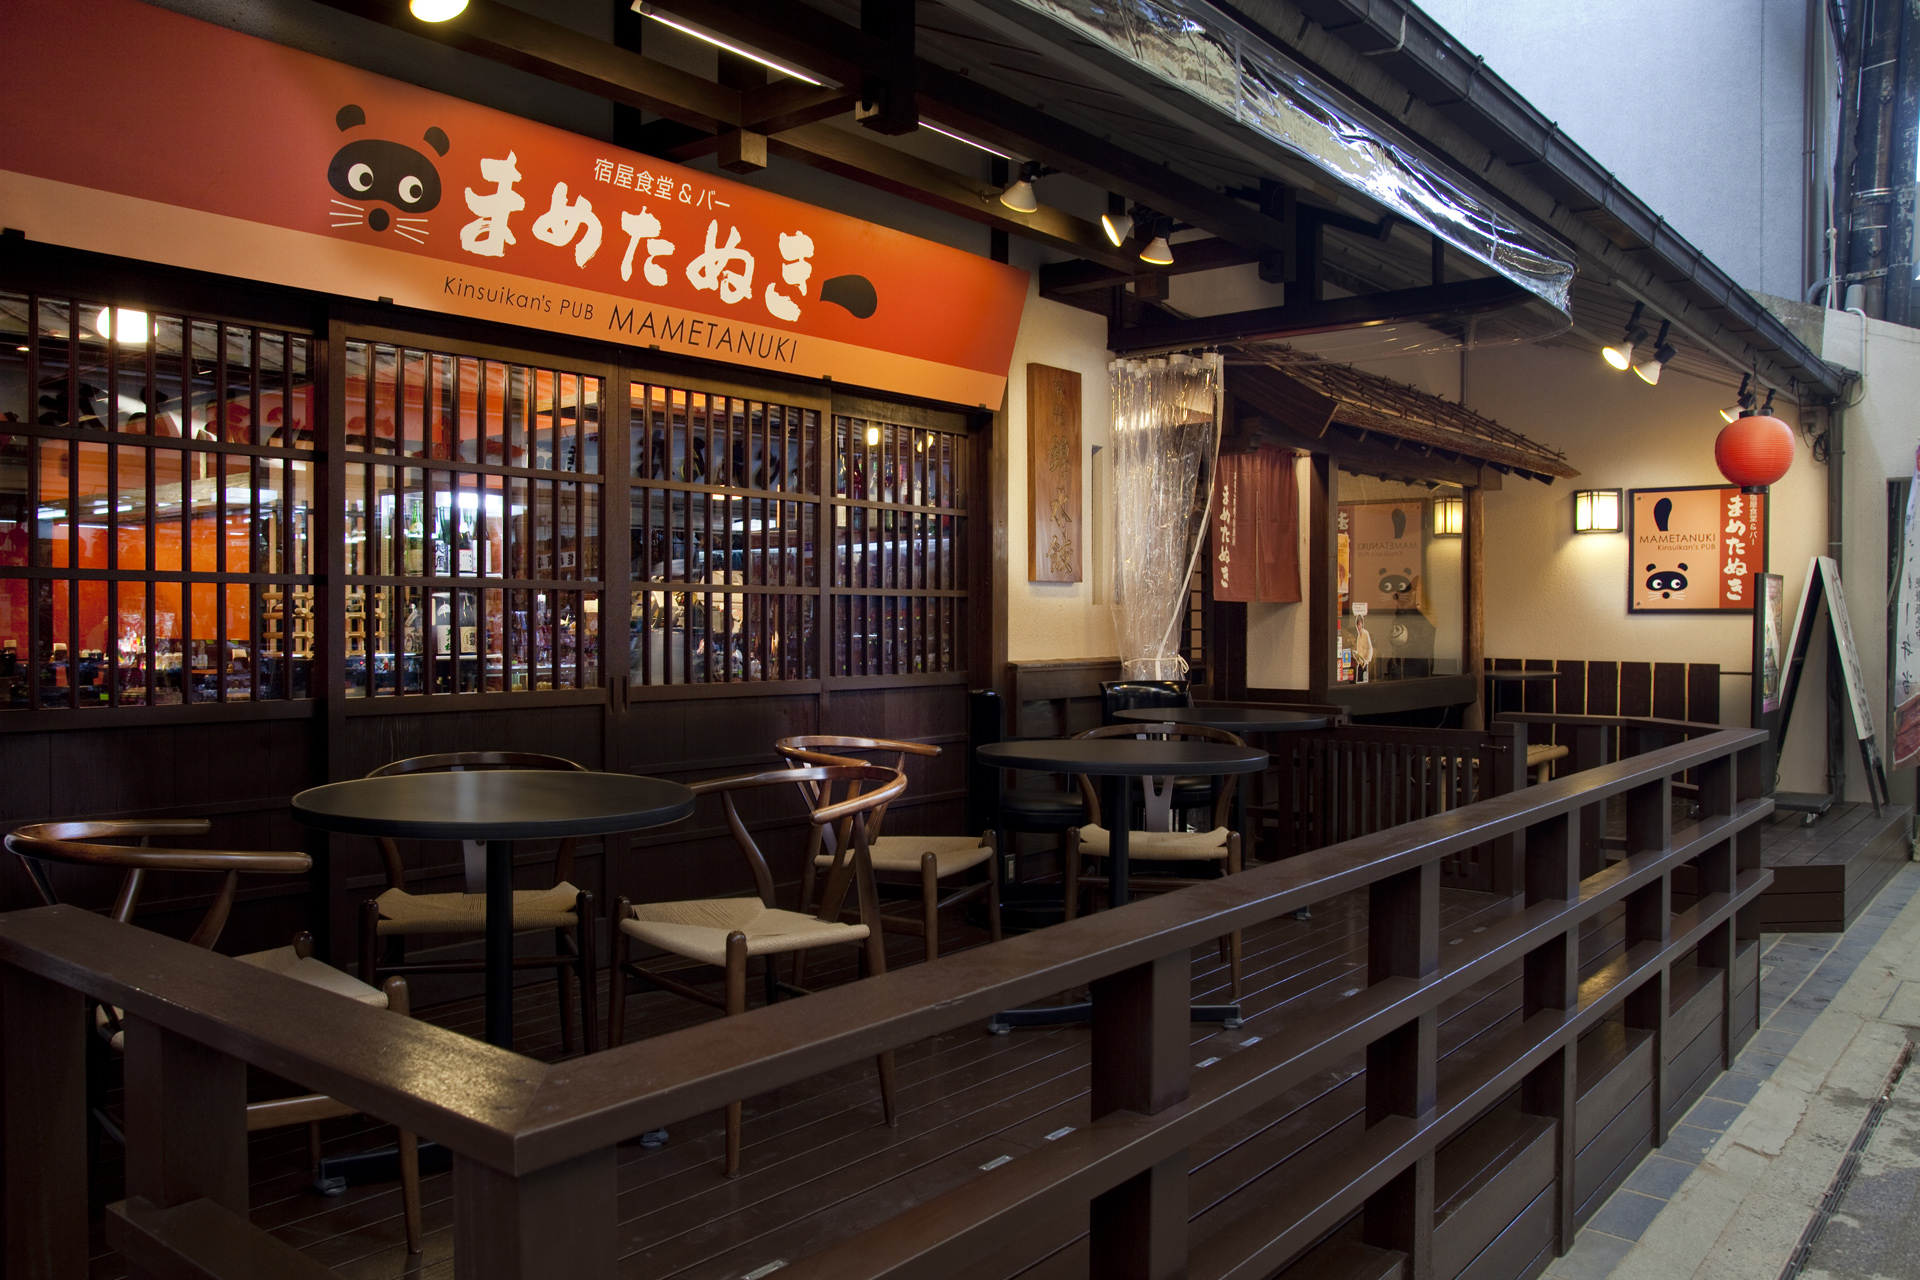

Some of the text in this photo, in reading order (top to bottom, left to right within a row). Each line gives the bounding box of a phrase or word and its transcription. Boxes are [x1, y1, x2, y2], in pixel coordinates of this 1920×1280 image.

[459, 150, 814, 322] まめたぬき
[444, 276, 798, 364] Kinsuikan's PUB MAMETANUKI
[1218, 485, 1231, 588] まめたぬき
[1639, 533, 1716, 544] MAMETANUKI
[1657, 544, 1699, 552] Kinsuikan's
[1723, 495, 1748, 601] まめたぬき
